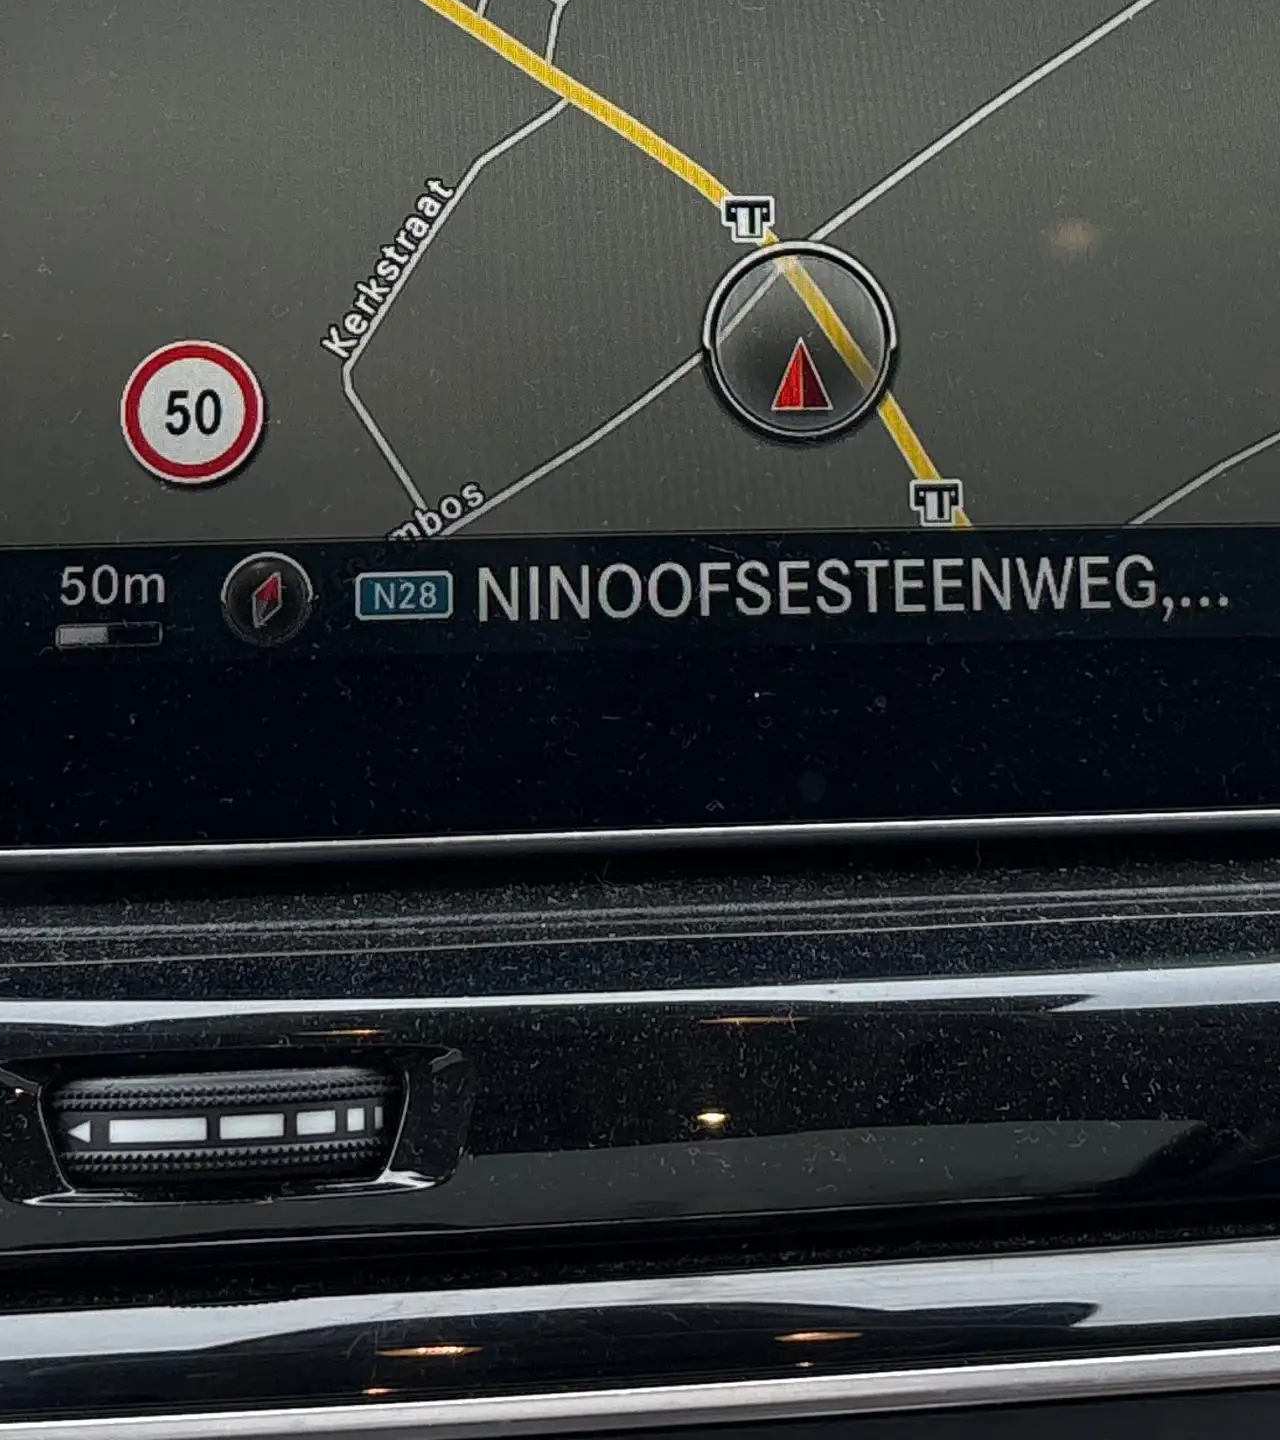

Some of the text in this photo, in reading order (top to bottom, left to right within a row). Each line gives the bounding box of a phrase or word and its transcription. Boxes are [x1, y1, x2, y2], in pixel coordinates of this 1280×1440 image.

[321, 177, 455, 359] Kerkstraat
[164, 389, 222, 436] 50
[59, 564, 166, 608] 50m
[373, 581, 437, 610] N28
